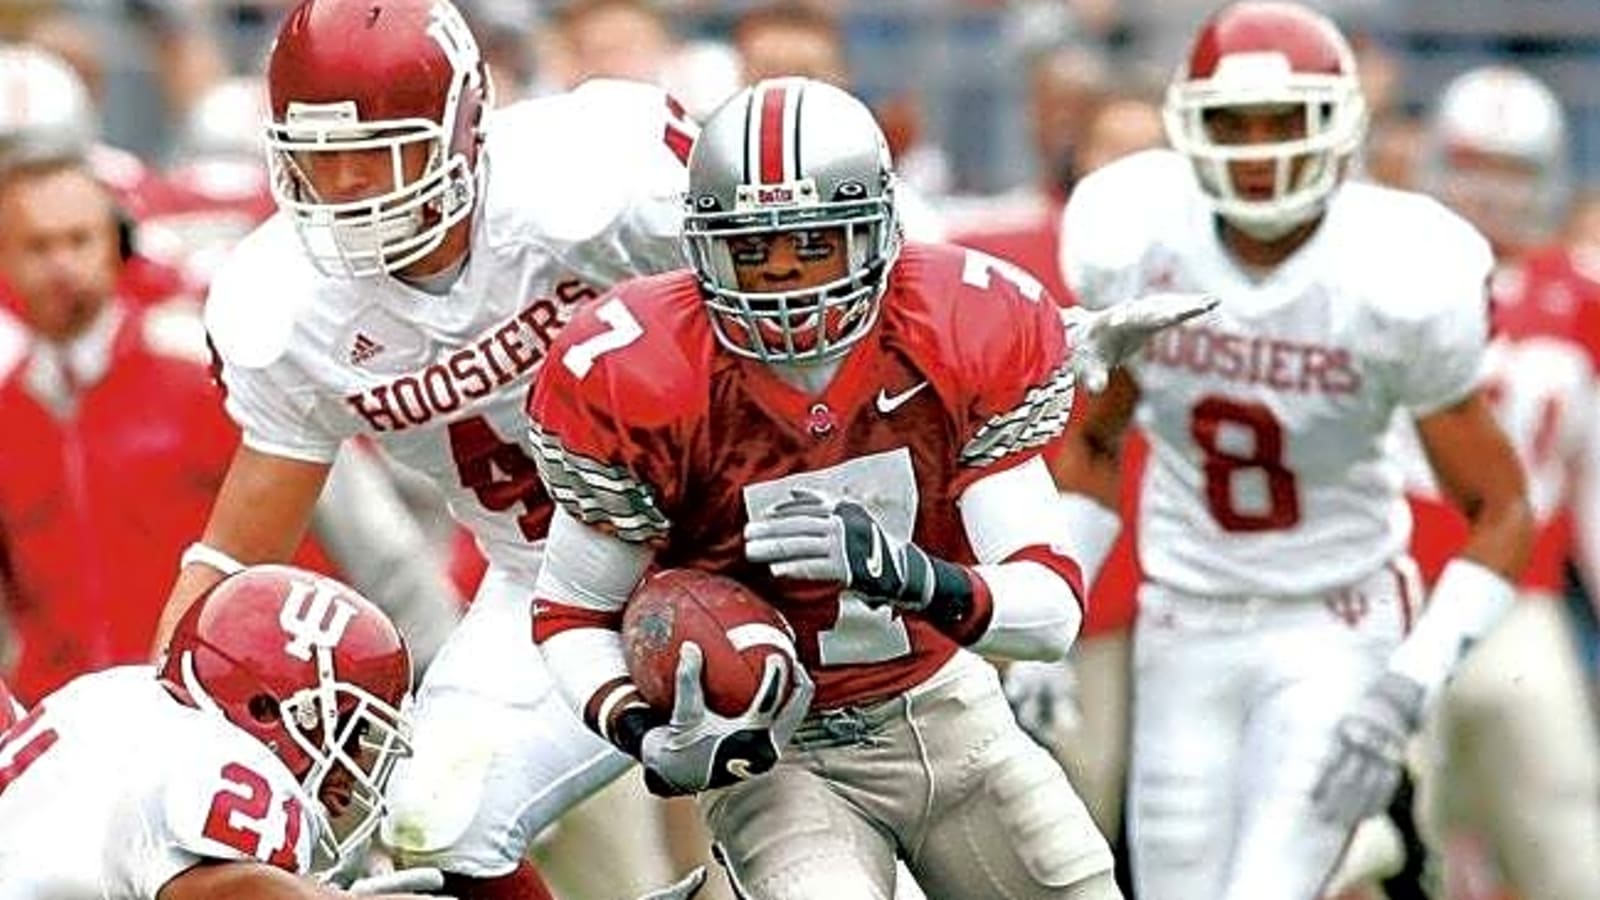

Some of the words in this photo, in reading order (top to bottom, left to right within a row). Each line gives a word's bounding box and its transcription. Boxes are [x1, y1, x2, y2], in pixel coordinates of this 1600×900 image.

[347, 280, 598, 431] HOOSIERS
[562, 297, 645, 381] 7
[1190, 396, 1300, 534] 8
[744, 447, 919, 665] 7
[202, 762, 303, 873] 21
